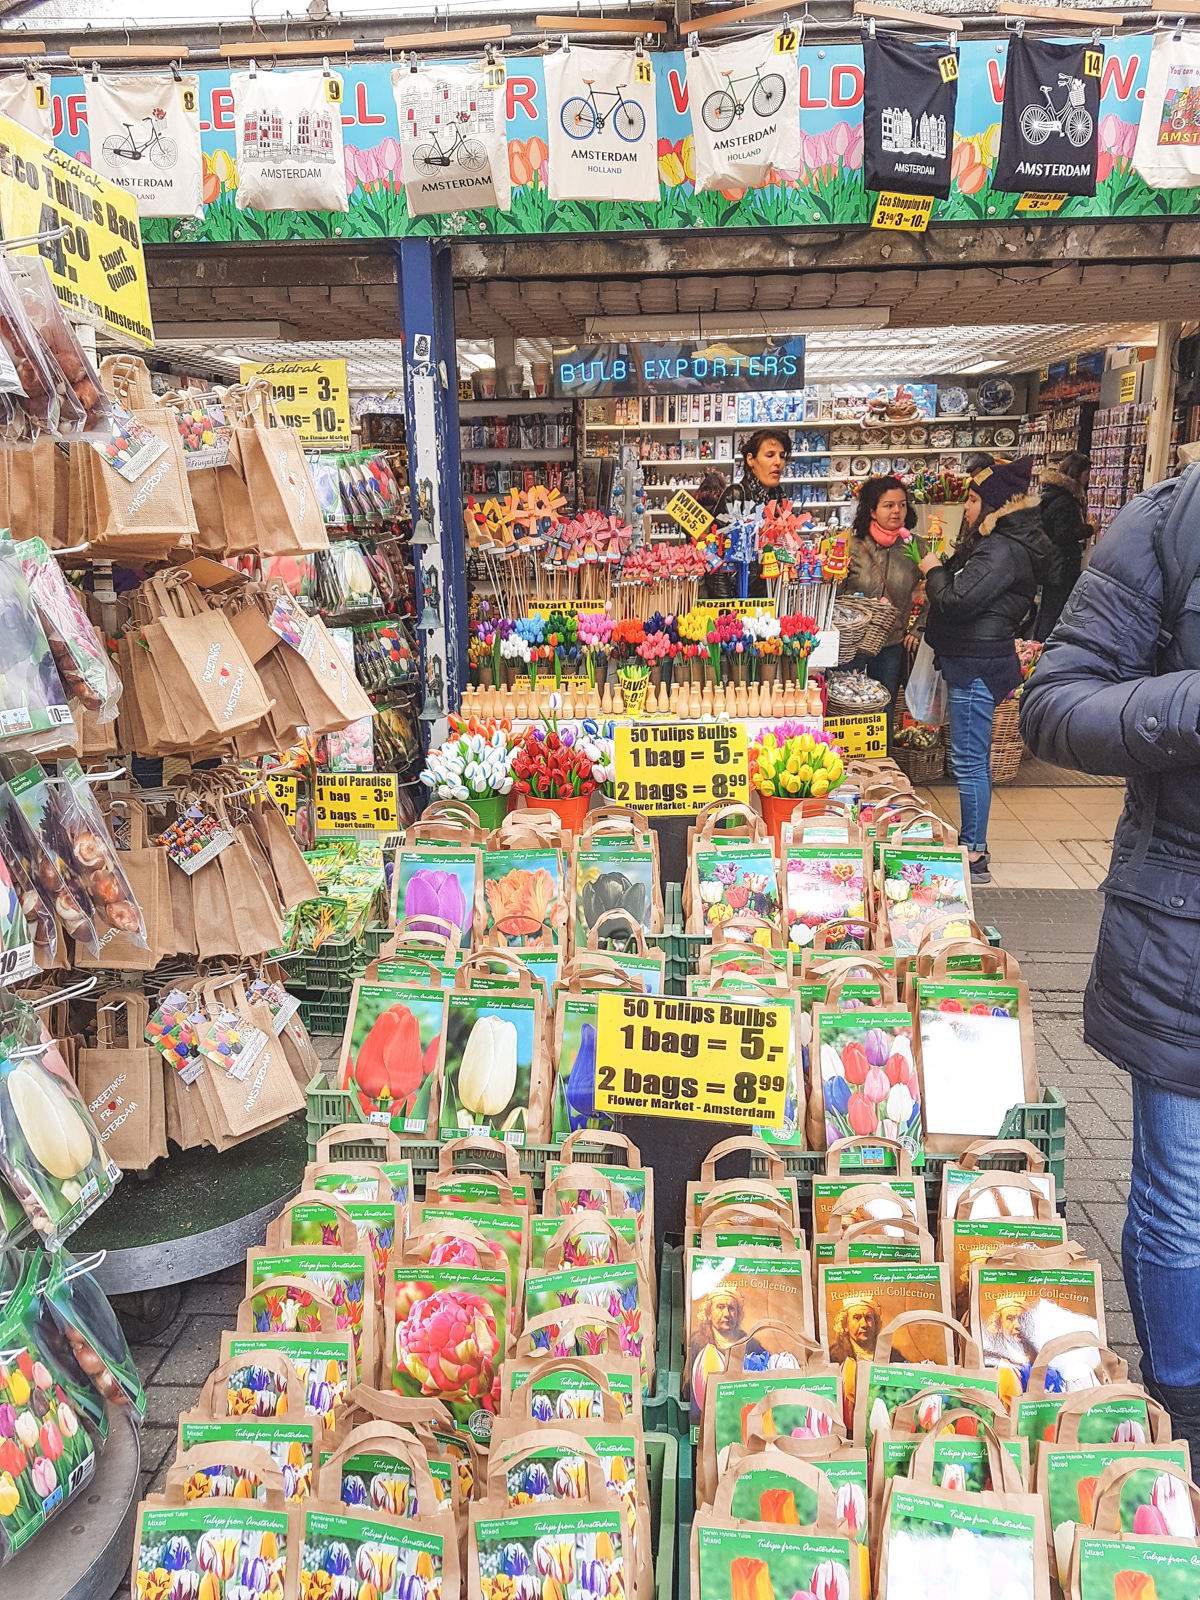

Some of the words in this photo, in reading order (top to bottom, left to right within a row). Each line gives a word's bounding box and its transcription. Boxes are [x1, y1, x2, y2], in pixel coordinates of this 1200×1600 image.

[777, 32, 795, 52] 12
[637, 62, 651, 82] 11
[941, 58, 955, 78] 13
[1087, 54, 1100, 74] 14
[486, 67, 504, 86] 10
[330, 81, 339, 100] 9
[184, 92, 194, 110] 8
[713, 124, 777, 150] AMSTERDAM
[571, 149, 638, 162] AMSTERDAM
[727, 147, 761, 161] HOLLAND
[43, 148, 104, 193] Laddrak
[260, 168, 322, 179] AMSTERDAM
[587, 166, 622, 174] HOLLAND
[894, 162, 936, 176] AMSTERDAM
[1015, 161, 1091, 177] AMSTERDAM
[421, 175, 492, 193] AMSTERDAM
[0, 143, 39, 190] Eco
[42, 164, 104, 226] Tulips
[106, 202, 140, 250] Bag
[879, 194, 891, 207] Eco
[892, 197, 920, 211] Shopping
[921, 199, 932, 211] Bag
[1028, 201, 1049, 209] 3.50
[99, 246, 128, 272] Export
[107, 265, 138, 292] Quality
[104, 308, 152, 341] Amsterdam
[256, 363, 324, 374] Laddrak
[560, 360, 627, 383] BULB
[644, 355, 797, 380] EXPORTERS
[127, 461, 172, 515] AMSTERDAM
[677, 492, 708, 525] Mills
[564, 601, 604, 610] Tulips
[697, 600, 733, 608] Mozart
[734, 600, 774, 608] Tulips
[202, 642, 221, 683] GREETINGS
[223, 666, 245, 720] AMSTERDAM
[48, 708, 61, 722] 10
[840, 715, 881, 726] Hortensia
[631, 728, 648, 742] 50
[651, 728, 694, 742] Tulips
[698, 725, 737, 739] Bulbs
[867, 725, 884, 736] 3.50
[630, 748, 640, 767] 1
[645, 748, 685, 768] bag
[317, 776, 337, 786] Bird
[338, 776, 347, 786] of
[350, 776, 391, 787] Paradise
[617, 782, 629, 800] 2
[635, 782, 688, 802] bags
[712, 774, 747, 798] 8.99
[275, 784, 294, 797] 3.50
[316, 788, 324, 801] 1
[330, 791, 350, 802] bag
[374, 789, 393, 802] 3.50
[317, 807, 326, 820] 3
[330, 810, 357, 821] bags
[625, 803, 653, 811] Flower
[656, 802, 685, 811] Market
[624, 998, 649, 1018] 50
[653, 1000, 715, 1024] Tulips
[720, 1006, 777, 1028] Bulbs
[620, 1025, 634, 1049] 1
[642, 1026, 699, 1058] bag
[243, 1053, 272, 1113] AMSTERDAM
[598, 1066, 616, 1091] 2
[624, 1068, 698, 1099] bags
[734, 1072, 785, 1104] 8.99
[88, 1073, 127, 1113] GREETINGS
[607, 1095, 649, 1107] Flower
[651, 1098, 694, 1112] Market
[704, 1103, 775, 1119] Amsterdam
[299, 1261, 316, 1270] Tulips
[316, 1261, 330, 1270] from
[751, 1279, 797, 1294] Collection
[873, 1274, 890, 1282] Tulips
[891, 1274, 905, 1282] from
[1044, 1276, 1058, 1284] from
[830, 1286, 884, 1300] Rembrandt
[886, 1286, 935, 1300] Collection
[984, 1288, 1036, 1300] Rembrandt
[1039, 1288, 1089, 1303] Collection
[70, 1465, 85, 1490] 10
[897, 1503, 914, 1511] Mixed
[148, 1519, 167, 1528] Mixed
[203, 1515, 225, 1527] Tulips
[225, 1516, 244, 1528] from
[246, 1517, 285, 1528] Amsterdam
[310, 1521, 328, 1530] Mixed
[534, 1522, 557, 1532] Tulips
[557, 1522, 575, 1533] from
[577, 1520, 617, 1529] Amsterdam
[950, 1510, 972, 1521] Tulips
[972, 1513, 989, 1525] from
[992, 1517, 1031, 1531] Amsterdam
[361, 1527, 382, 1539] Tulips
[382, 1529, 400, 1542] from
[401, 1534, 440, 1551] Amsterdam
[758, 1539, 780, 1550] Tulips
[781, 1541, 800, 1552] from
[803, 1543, 845, 1554] Amsterdam
[1142, 1550, 1167, 1562] Tulips
[1167, 1553, 1187, 1565] from
